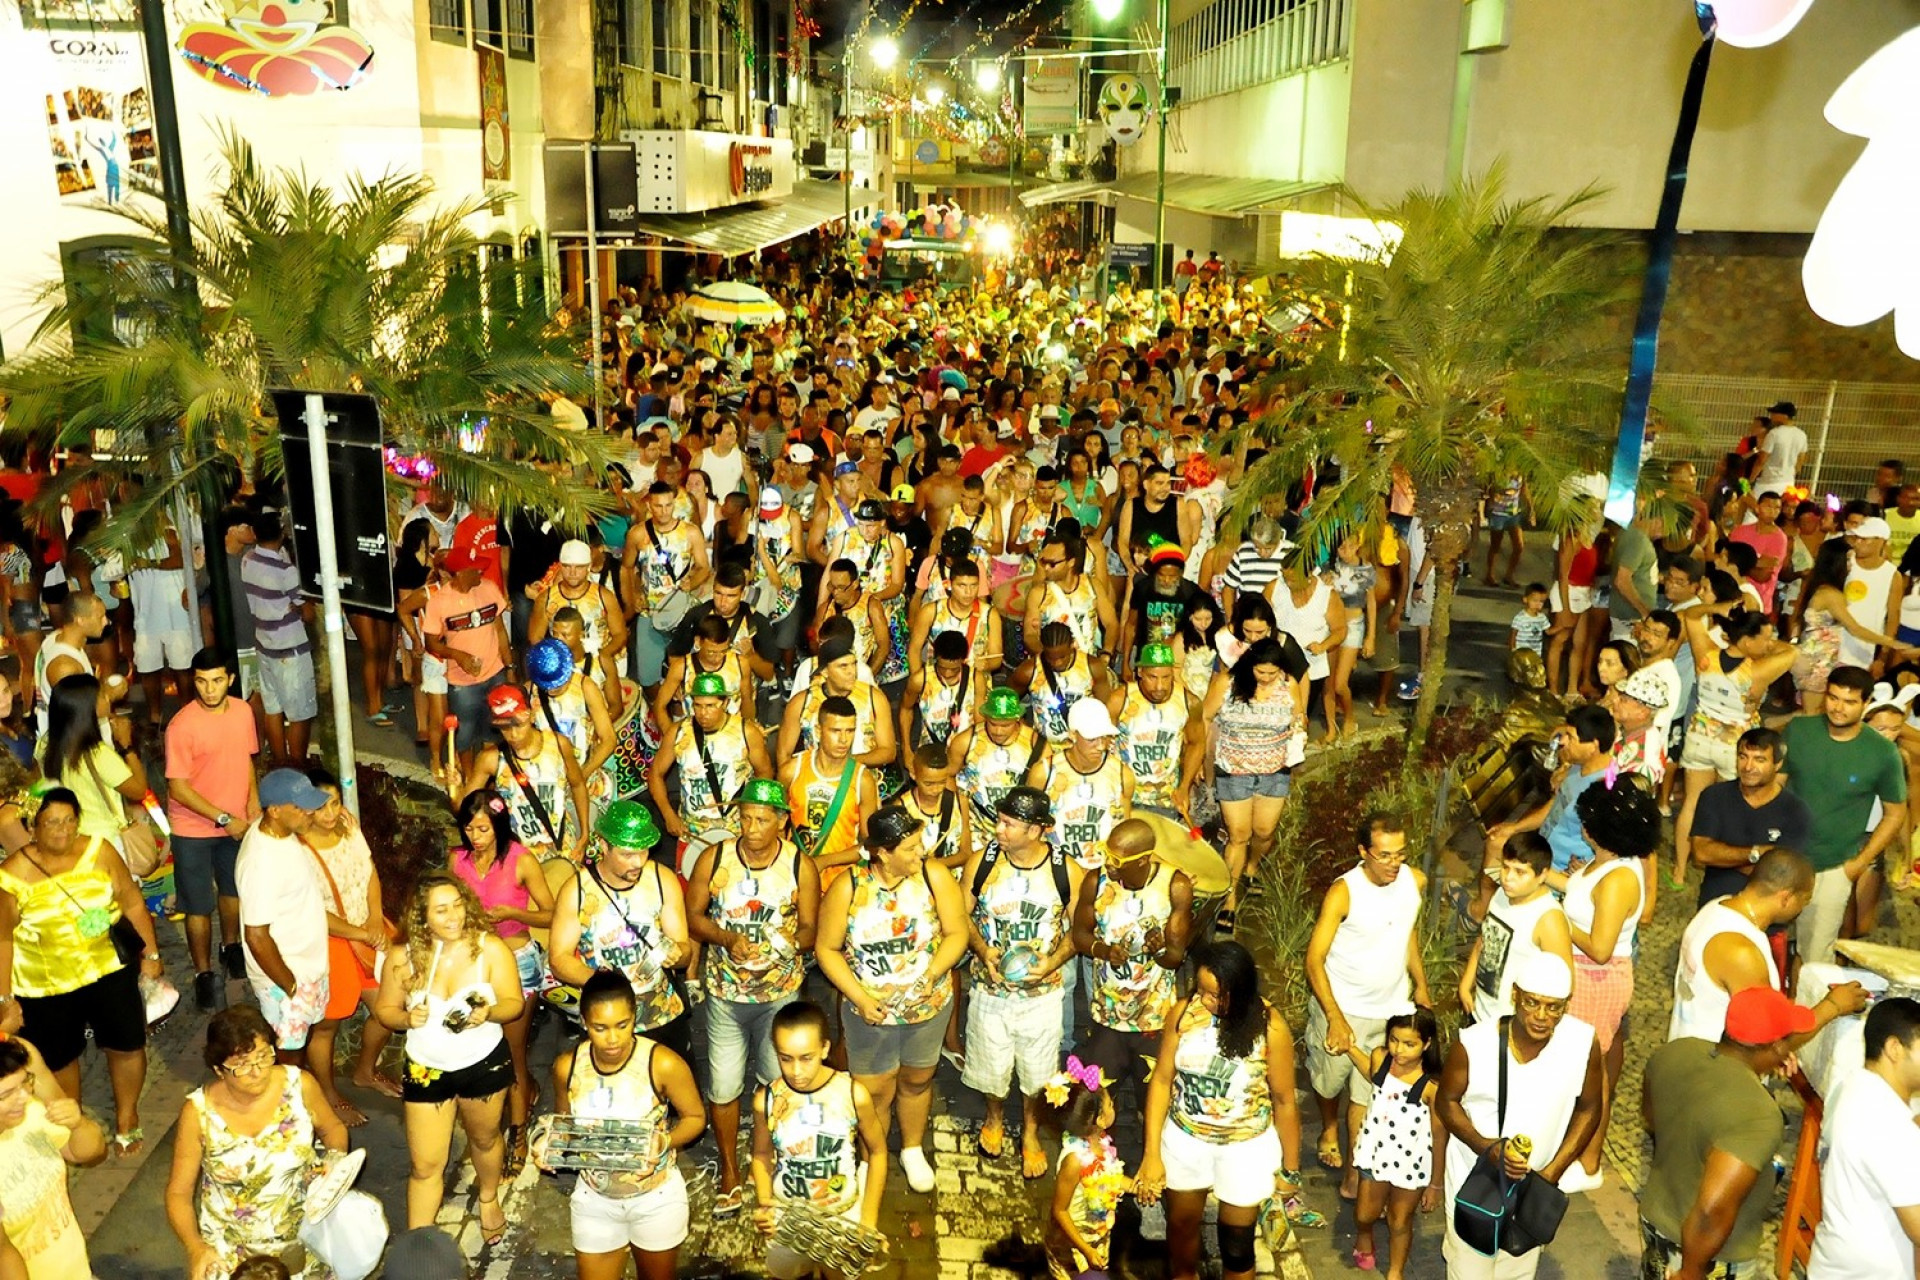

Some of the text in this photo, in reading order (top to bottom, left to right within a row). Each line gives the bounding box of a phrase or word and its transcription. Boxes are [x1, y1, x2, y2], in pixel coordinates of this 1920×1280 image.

[1133, 744, 1170, 761] PREN
[1132, 761, 1153, 777] SA
[521, 821, 542, 839] SA
[1063, 823, 1100, 842] PREN
[1060, 843, 1084, 860] SA
[1020, 900, 1048, 921] IM
[994, 918, 1040, 941] PREN
[860, 936, 915, 955] PREN
[866, 956, 892, 977] SA
[784, 1156, 842, 1179] PREN
[782, 1173, 811, 1200] SA
